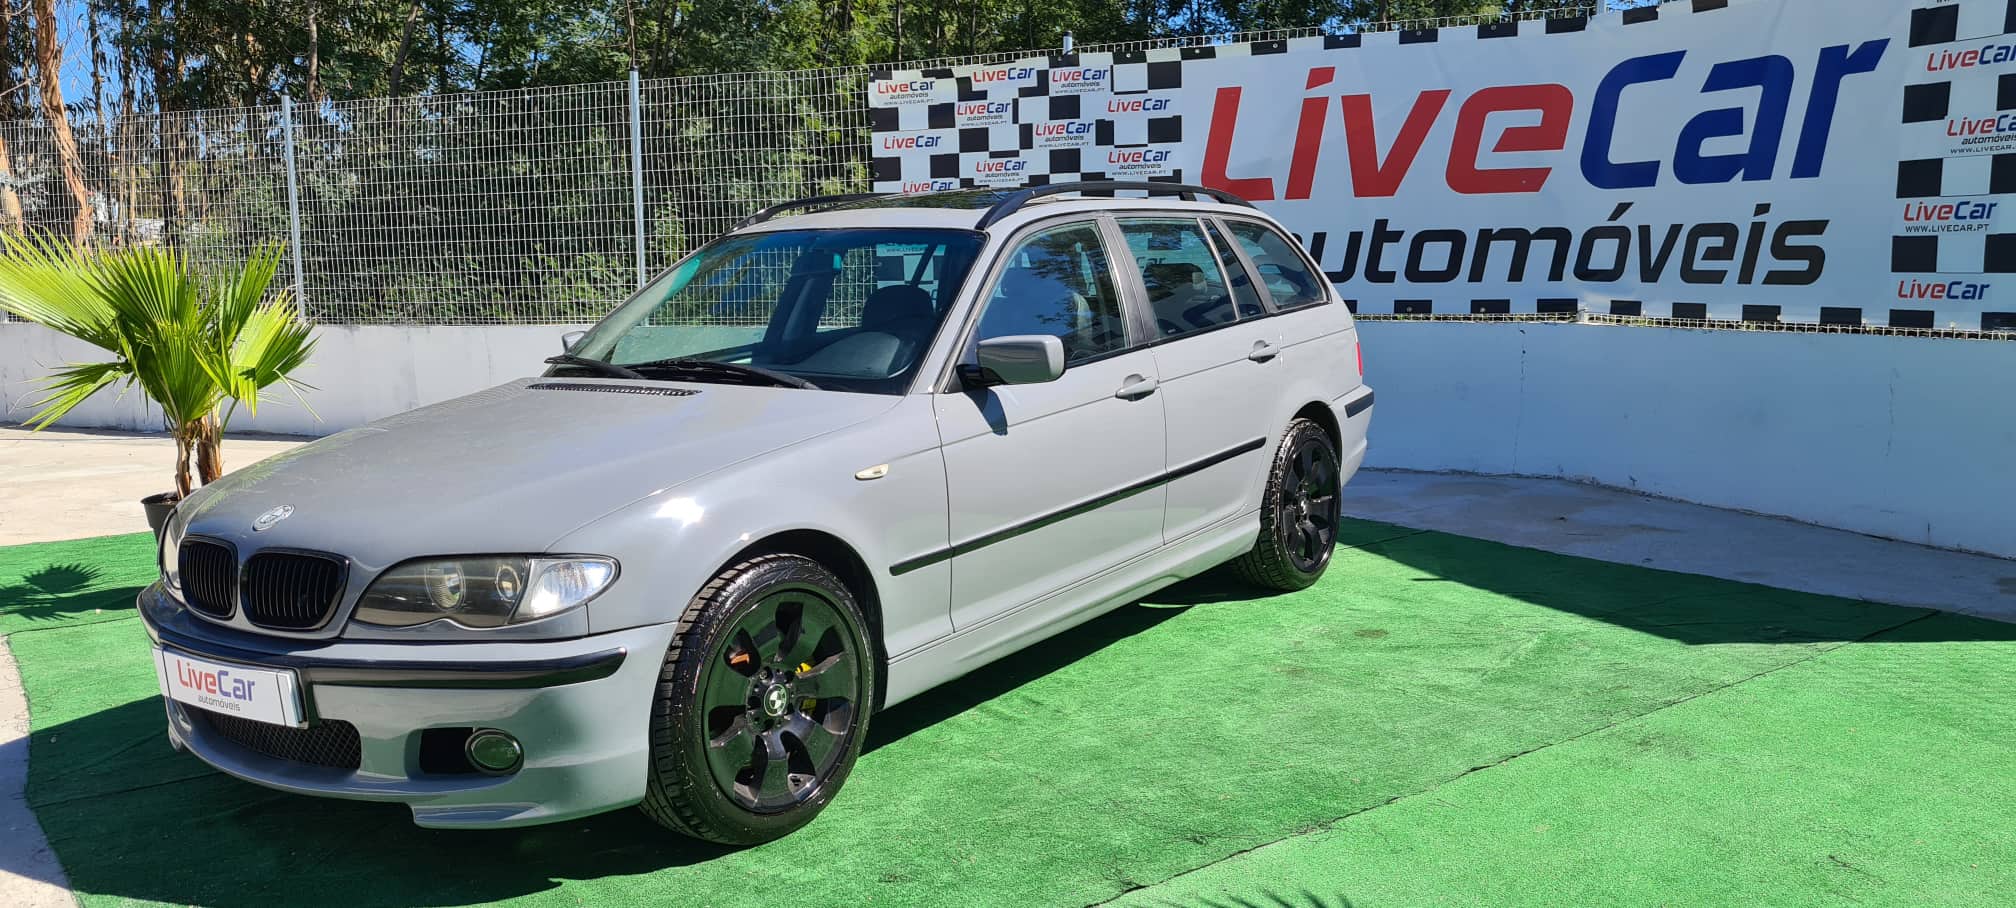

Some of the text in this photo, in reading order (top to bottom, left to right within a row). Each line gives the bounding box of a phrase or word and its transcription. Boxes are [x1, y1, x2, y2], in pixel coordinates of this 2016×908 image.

[973, 67, 1035, 83] LiveCar
[1052, 69, 1109, 83] LiveCar
[878, 81, 935, 94] LiveCar
[957, 102, 1011, 116] LiveCar
[1108, 98, 1171, 113] LiveCar
[1201, 38, 1890, 201] LiveCar
[1035, 121, 1094, 136] LiveCar
[884, 135, 941, 150] LiveCar
[1108, 149, 1171, 164] LiveCar
[976, 160, 1027, 173] LiveCar
[902, 181, 953, 193] LiveCar
[1904, 201, 1998, 222] LiveCar
[1905, 224, 1990, 233] WWW.LIVECAR.PT
[1291, 201, 1830, 285] utomóveis
[1898, 279, 1991, 300] LiveCar
[177, 659, 255, 702] LiveCar
